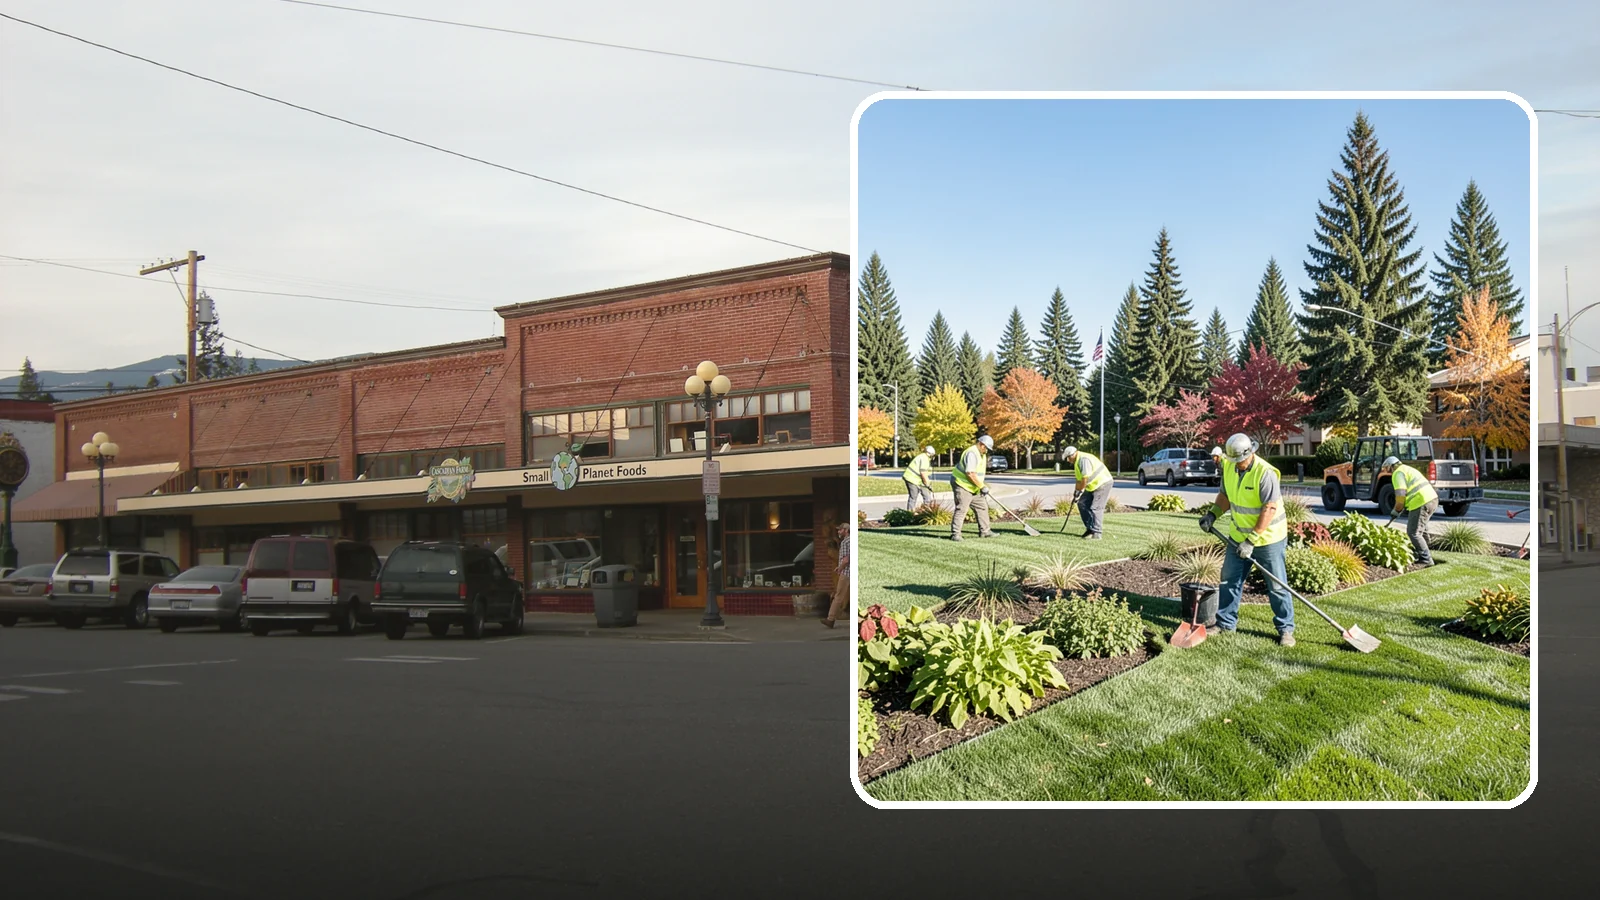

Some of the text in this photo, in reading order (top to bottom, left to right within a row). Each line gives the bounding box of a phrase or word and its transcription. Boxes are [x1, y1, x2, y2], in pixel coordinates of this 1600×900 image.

[522, 464, 647, 483] Small Planet Foods
